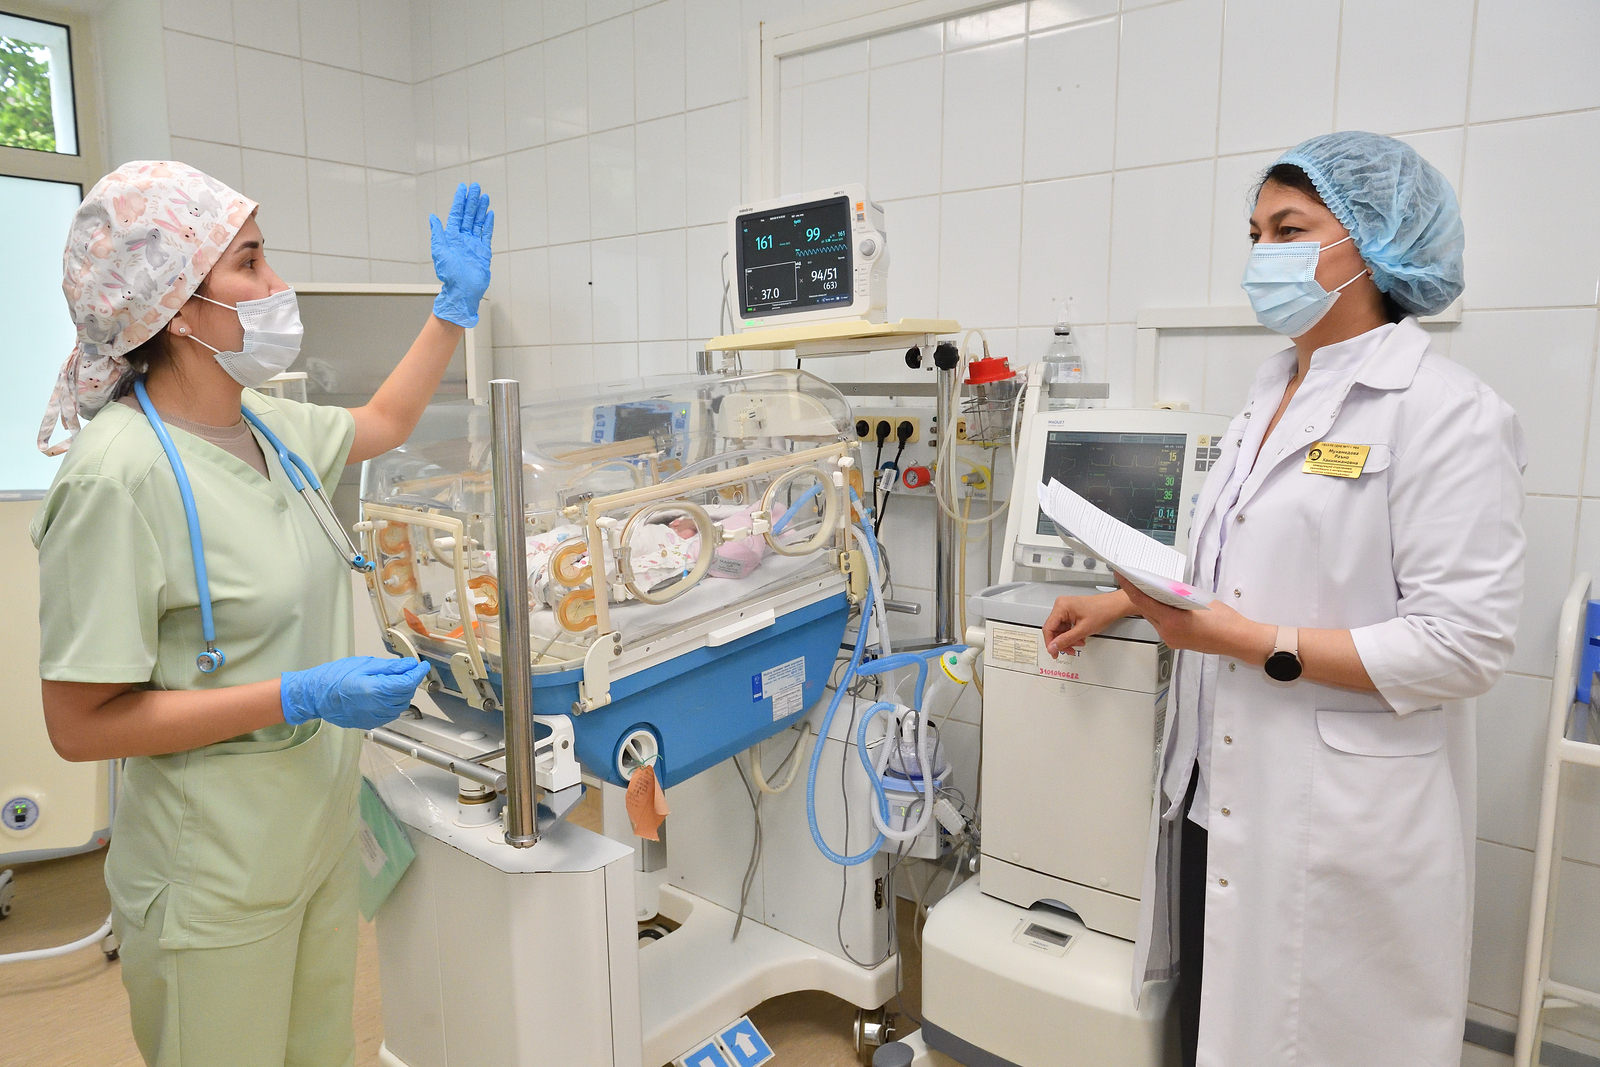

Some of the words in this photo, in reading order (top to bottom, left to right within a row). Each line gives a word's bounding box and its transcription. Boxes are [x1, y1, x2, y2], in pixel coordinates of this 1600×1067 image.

[806, 227, 821, 242] 99
[756, 235, 773, 251] 161
[811, 268, 838, 282] 94/51
[823, 281, 838, 290] (63)
[761, 288, 780, 300] 37.0
[1169, 452, 1177, 462] 15
[1165, 476, 1175, 486] 30
[1163, 490, 1173, 500] 35
[1158, 508, 1175, 519] 0.14
